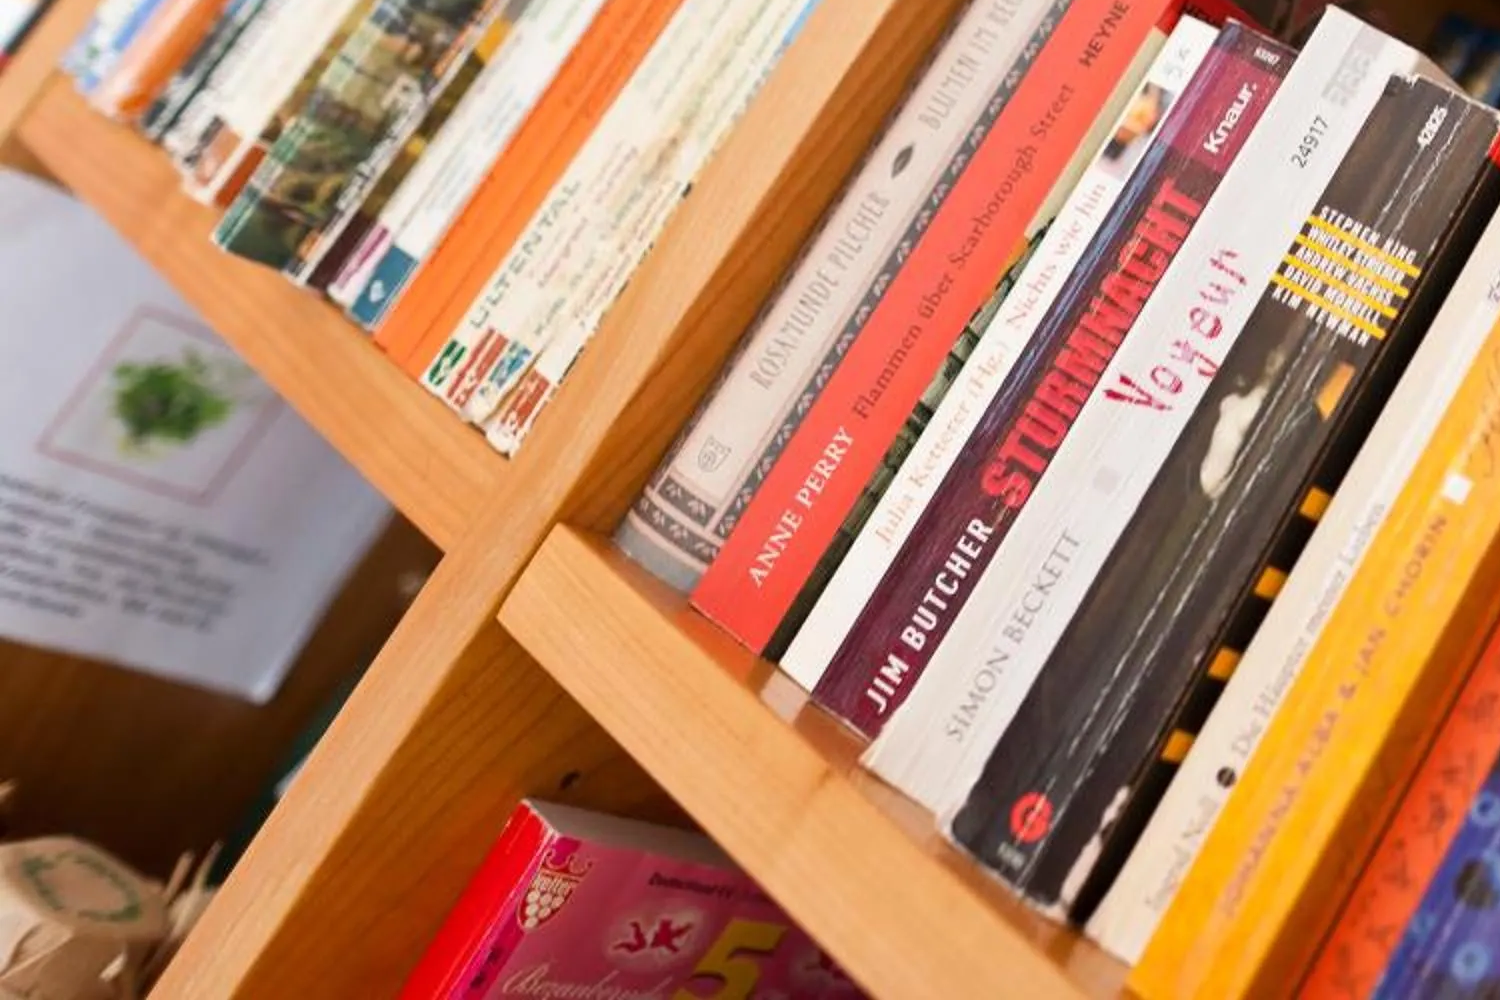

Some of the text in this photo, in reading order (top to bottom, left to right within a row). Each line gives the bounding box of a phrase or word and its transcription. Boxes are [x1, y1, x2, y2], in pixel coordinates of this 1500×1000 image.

[1201, 76, 1260, 155] Knaur.
[1288, 113, 1332, 170] 24917
[747, 267, 840, 391] ROSAMUNDE
[824, 186, 893, 272] PILCHER
[1005, 257, 1060, 331] Nichts
[1049, 213, 1087, 259] wie
[1074, 178, 1108, 218] hin
[1282, 264, 1324, 294] DAVID
[1316, 205, 1417, 265] STEPHEN KING
[742, 79, 1076, 588] ANNE PERRY Flammen über Scarborough Street
[1101, 249, 1239, 409] Voyeur
[1271, 285, 1372, 345] KIM NEWMAN
[859, 178, 1207, 714] JIM BUTCHER STURMNACHT
[941, 526, 1084, 743] SIMON BECKETT
